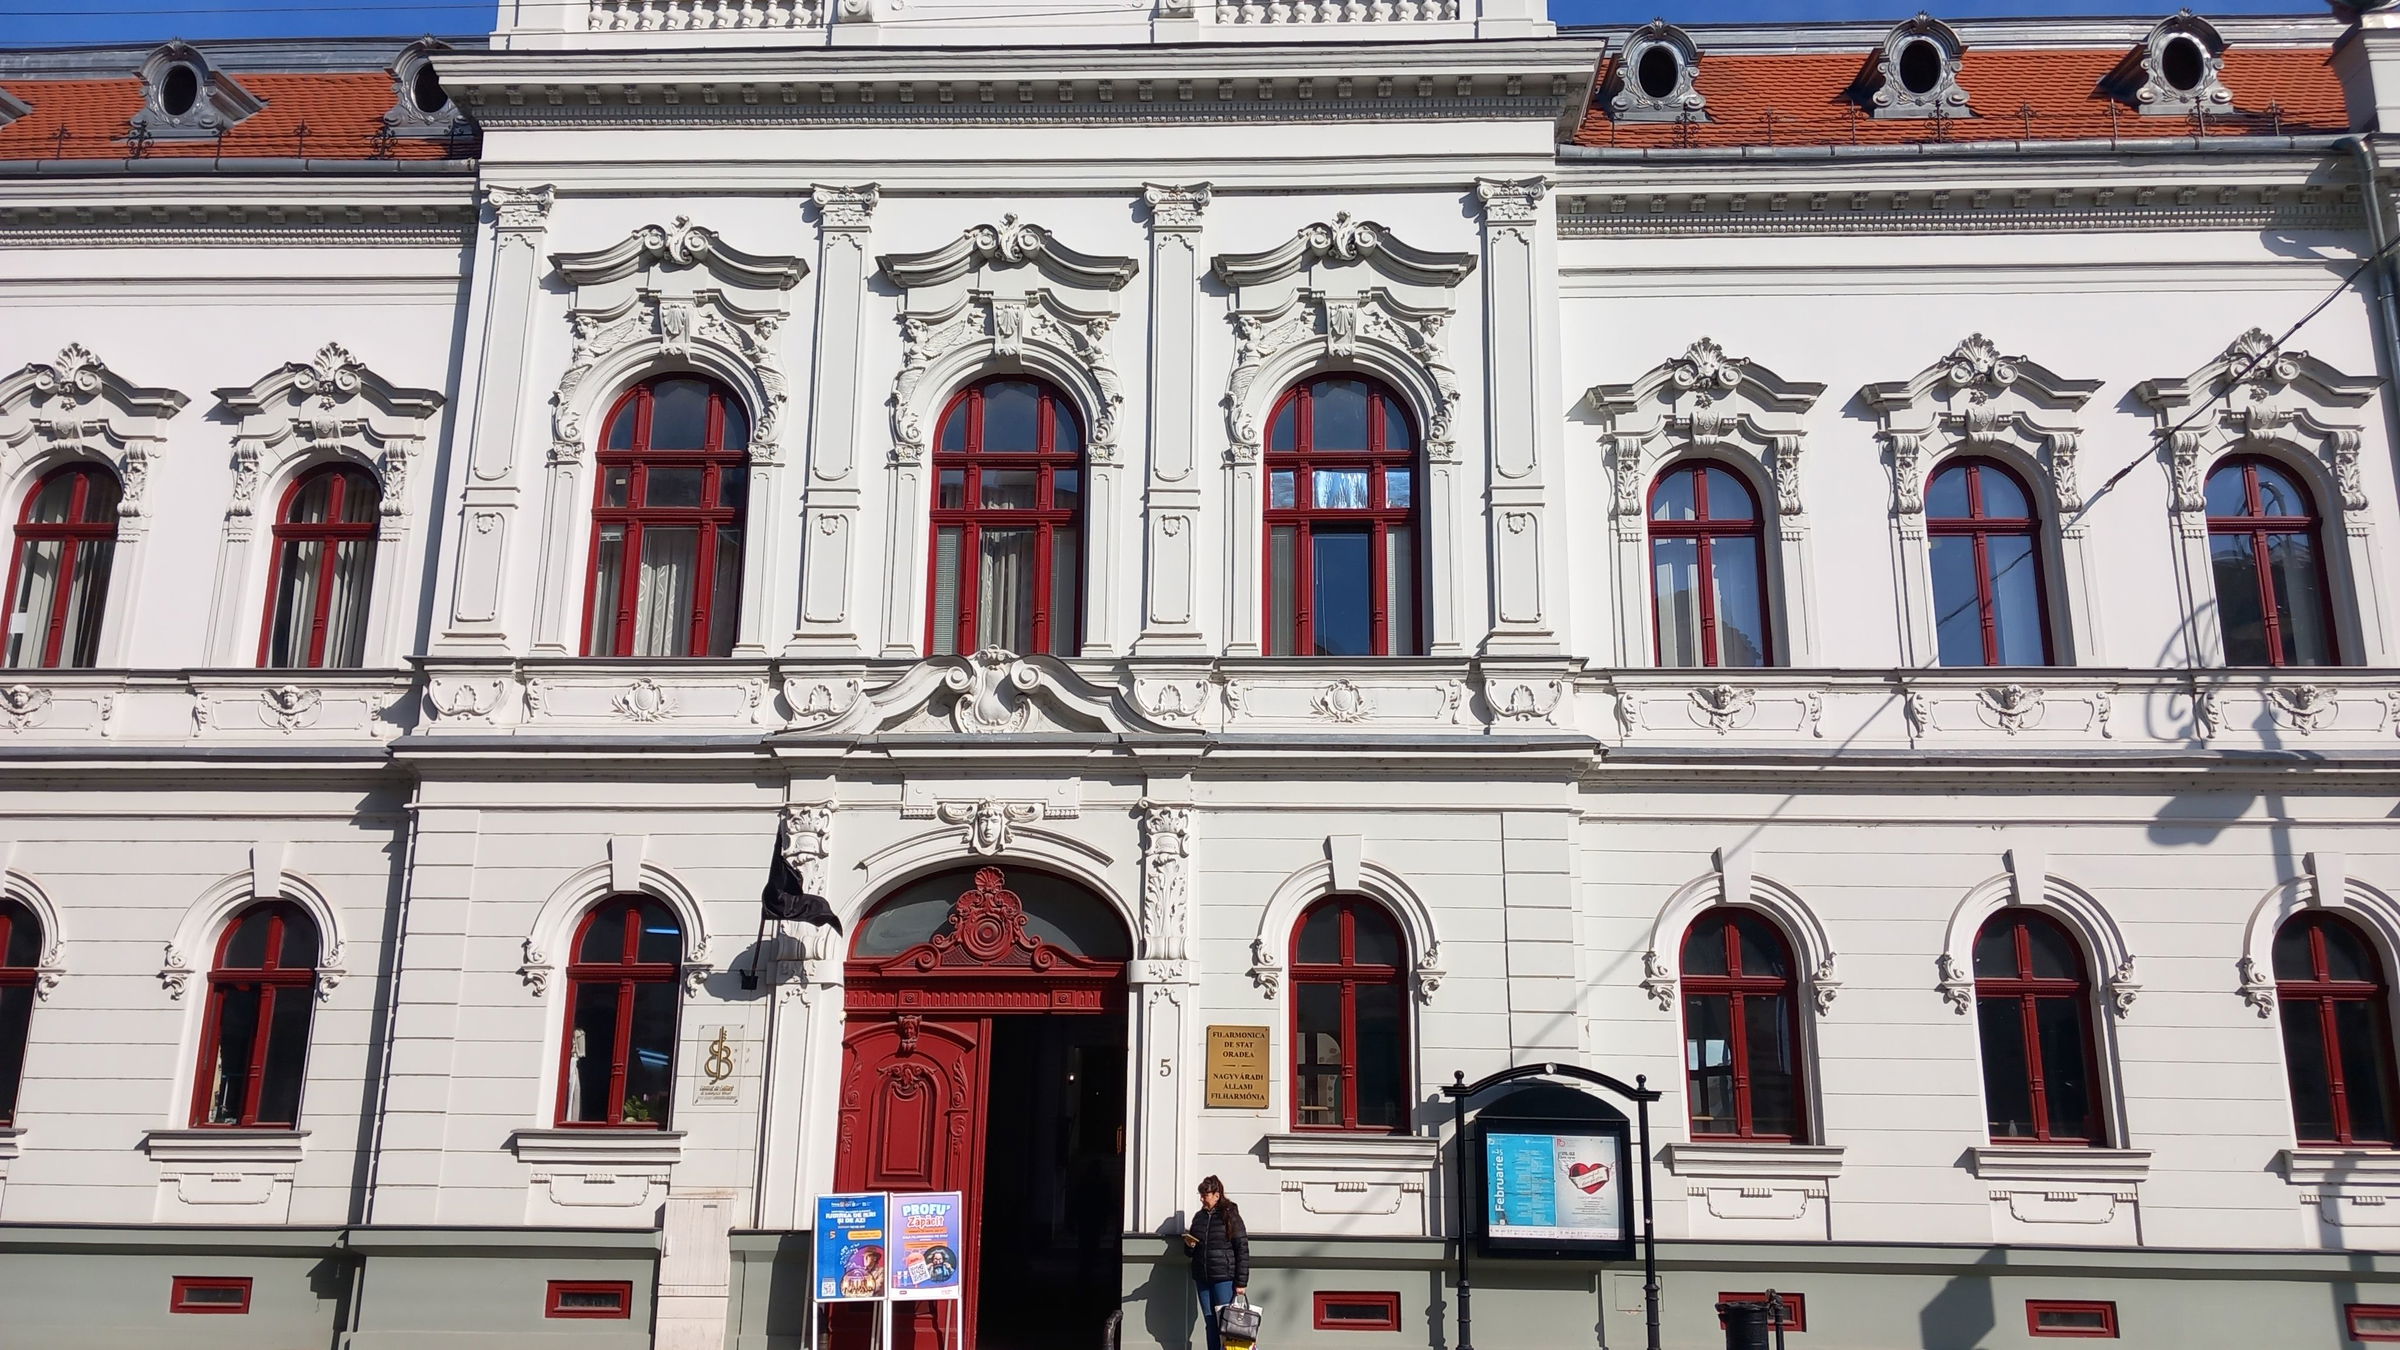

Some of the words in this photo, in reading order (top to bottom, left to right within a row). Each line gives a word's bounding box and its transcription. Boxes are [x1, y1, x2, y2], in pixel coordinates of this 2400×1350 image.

[1212, 1031, 1265, 1039] FILARMONICA
[1160, 1058, 1171, 1077] 5
[1213, 1072, 1264, 1080] NAGYVÁRADI
[1223, 1081, 1253, 1090] ÁLLAMI
[1211, 1091, 1265, 1100] FILHARMÓNIA
[1493, 1155, 1505, 1212] Februarie
